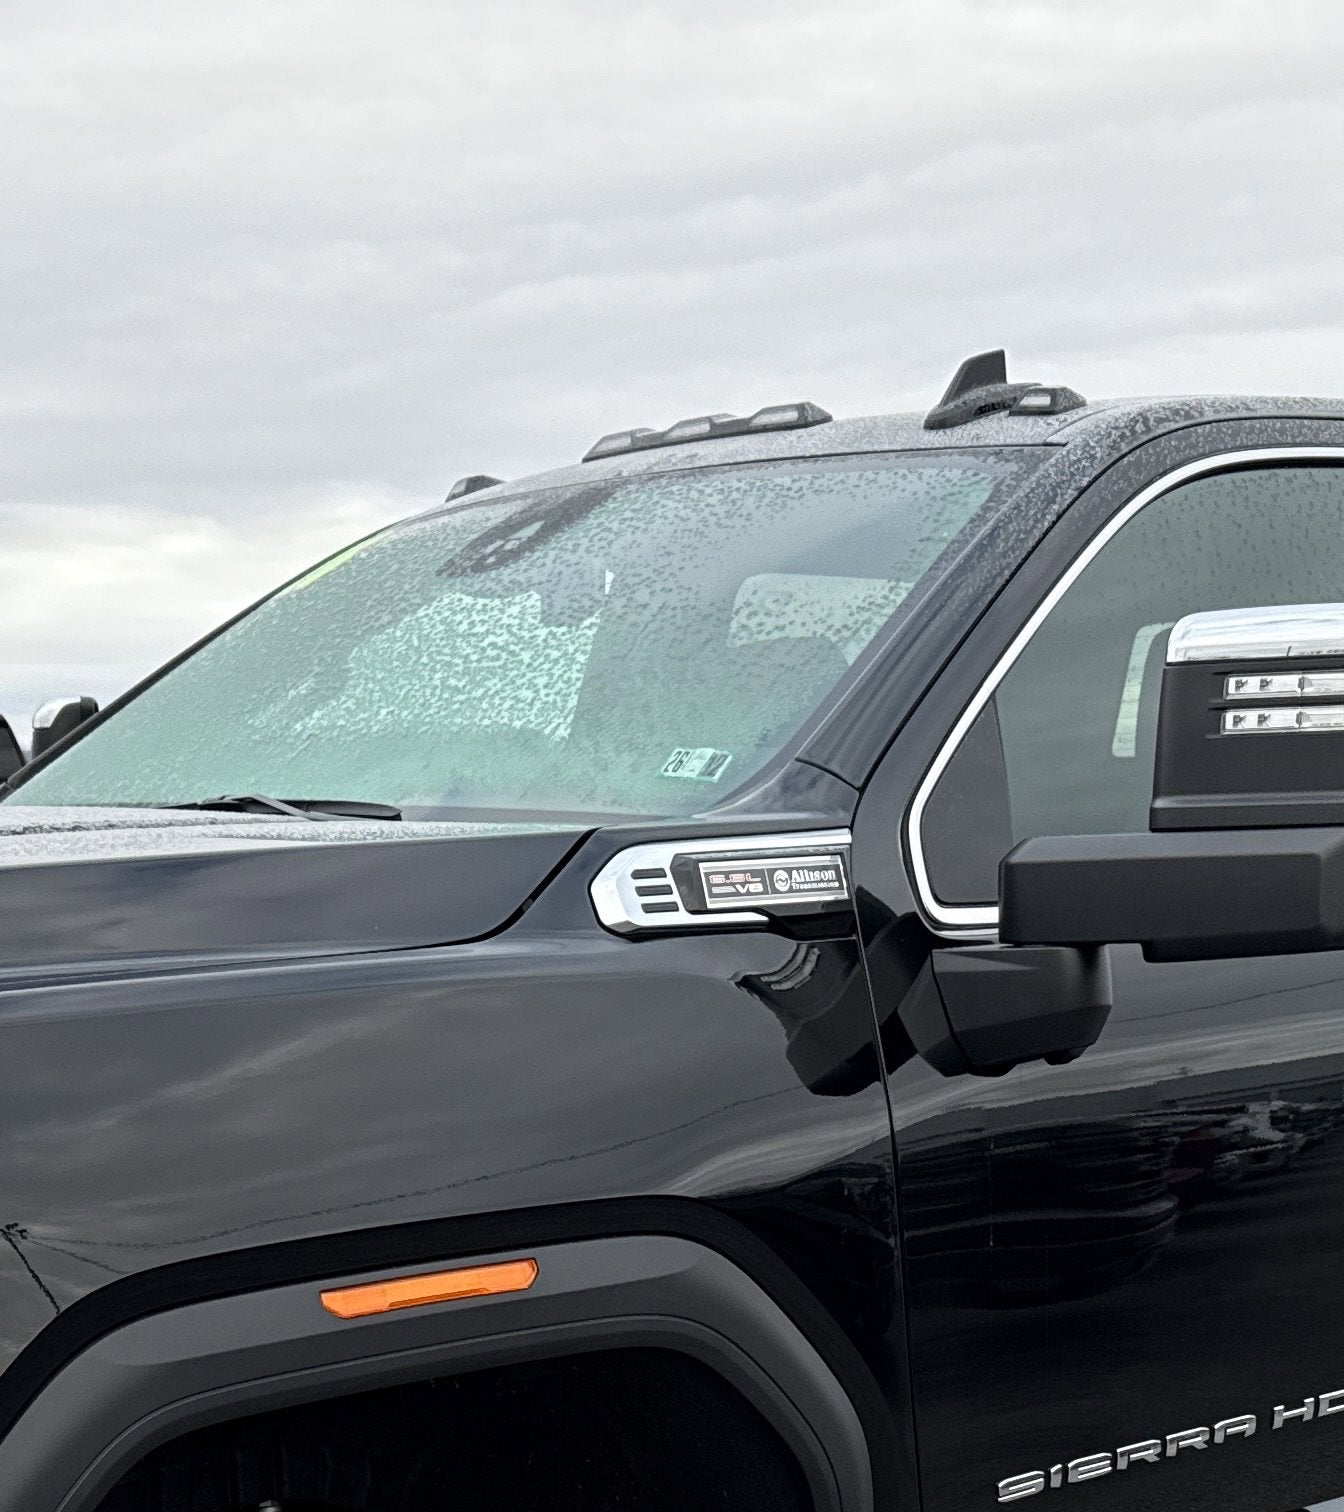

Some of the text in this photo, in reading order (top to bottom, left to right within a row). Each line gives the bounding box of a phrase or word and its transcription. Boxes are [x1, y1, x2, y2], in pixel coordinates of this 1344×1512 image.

[791, 869, 837, 883] Allison
[735, 882, 764, 894] V8
[997, 1414, 1257, 1503] SIERRA
